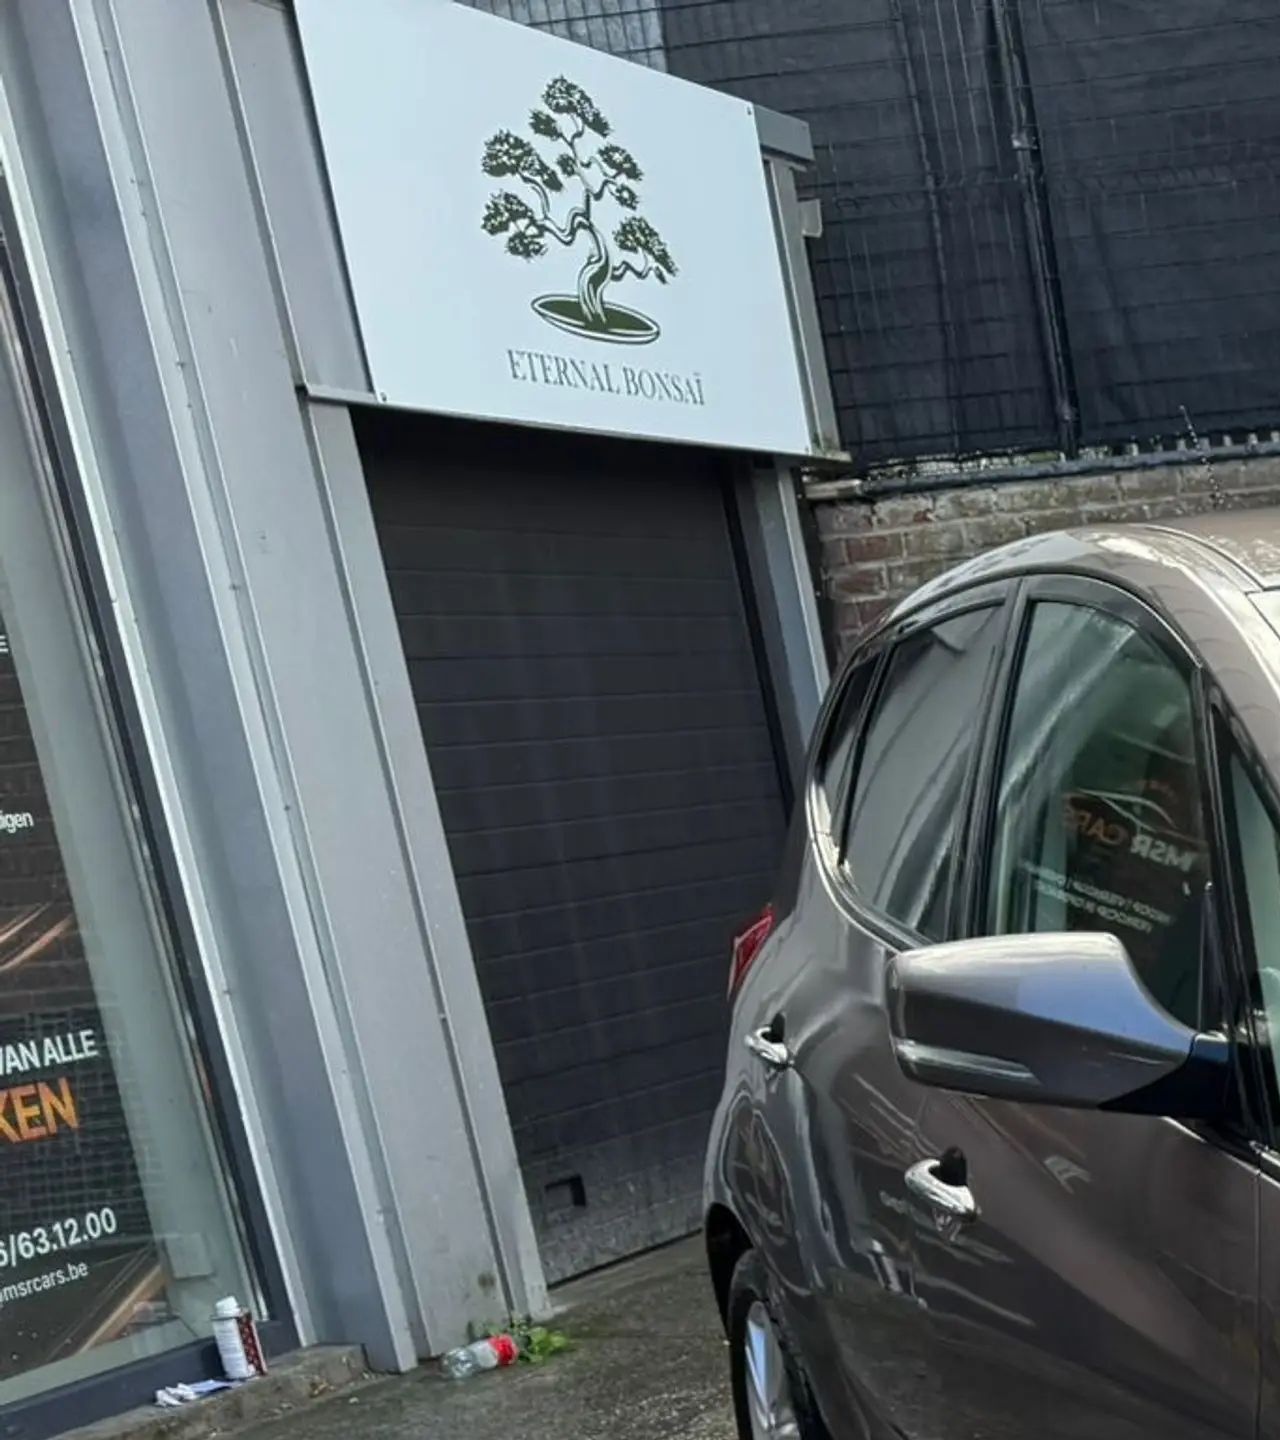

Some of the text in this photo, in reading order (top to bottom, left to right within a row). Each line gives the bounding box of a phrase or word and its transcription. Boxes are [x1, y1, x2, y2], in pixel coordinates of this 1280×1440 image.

[506, 349, 620, 395] ETERNAL
[43, 1029, 99, 1067] ALLE
[0, 1262, 89, 1305] msrcars.be
